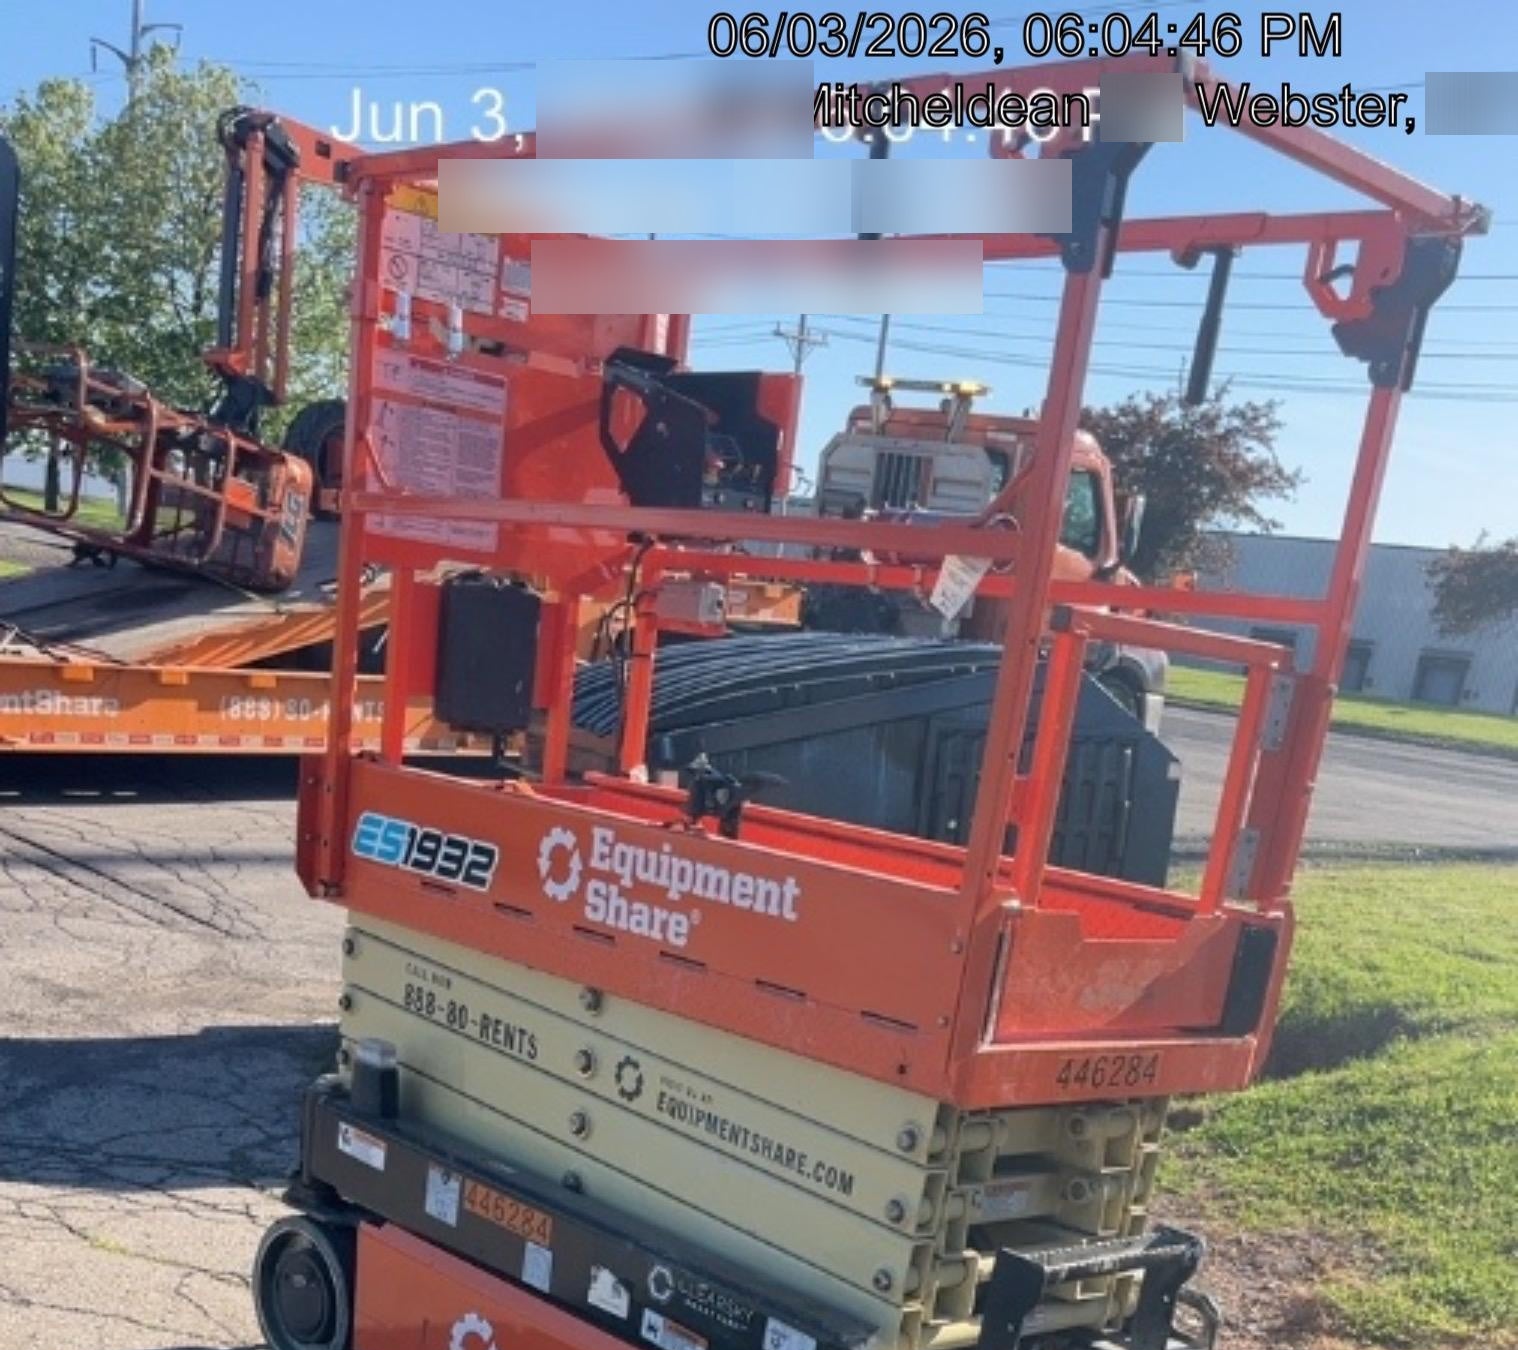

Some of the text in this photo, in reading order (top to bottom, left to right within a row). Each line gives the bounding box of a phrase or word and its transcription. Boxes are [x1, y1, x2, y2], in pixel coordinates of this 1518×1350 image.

[353, 812, 498, 891] ES1932
[588, 826, 801, 920] Equipment
[403, 982, 540, 1061] 888-80-RENTS
[1055, 1053, 1161, 1091] 446284
[656, 1090, 855, 1197] EQUIPMENTSHARE.COM
[464, 1182, 550, 1244] 446284
